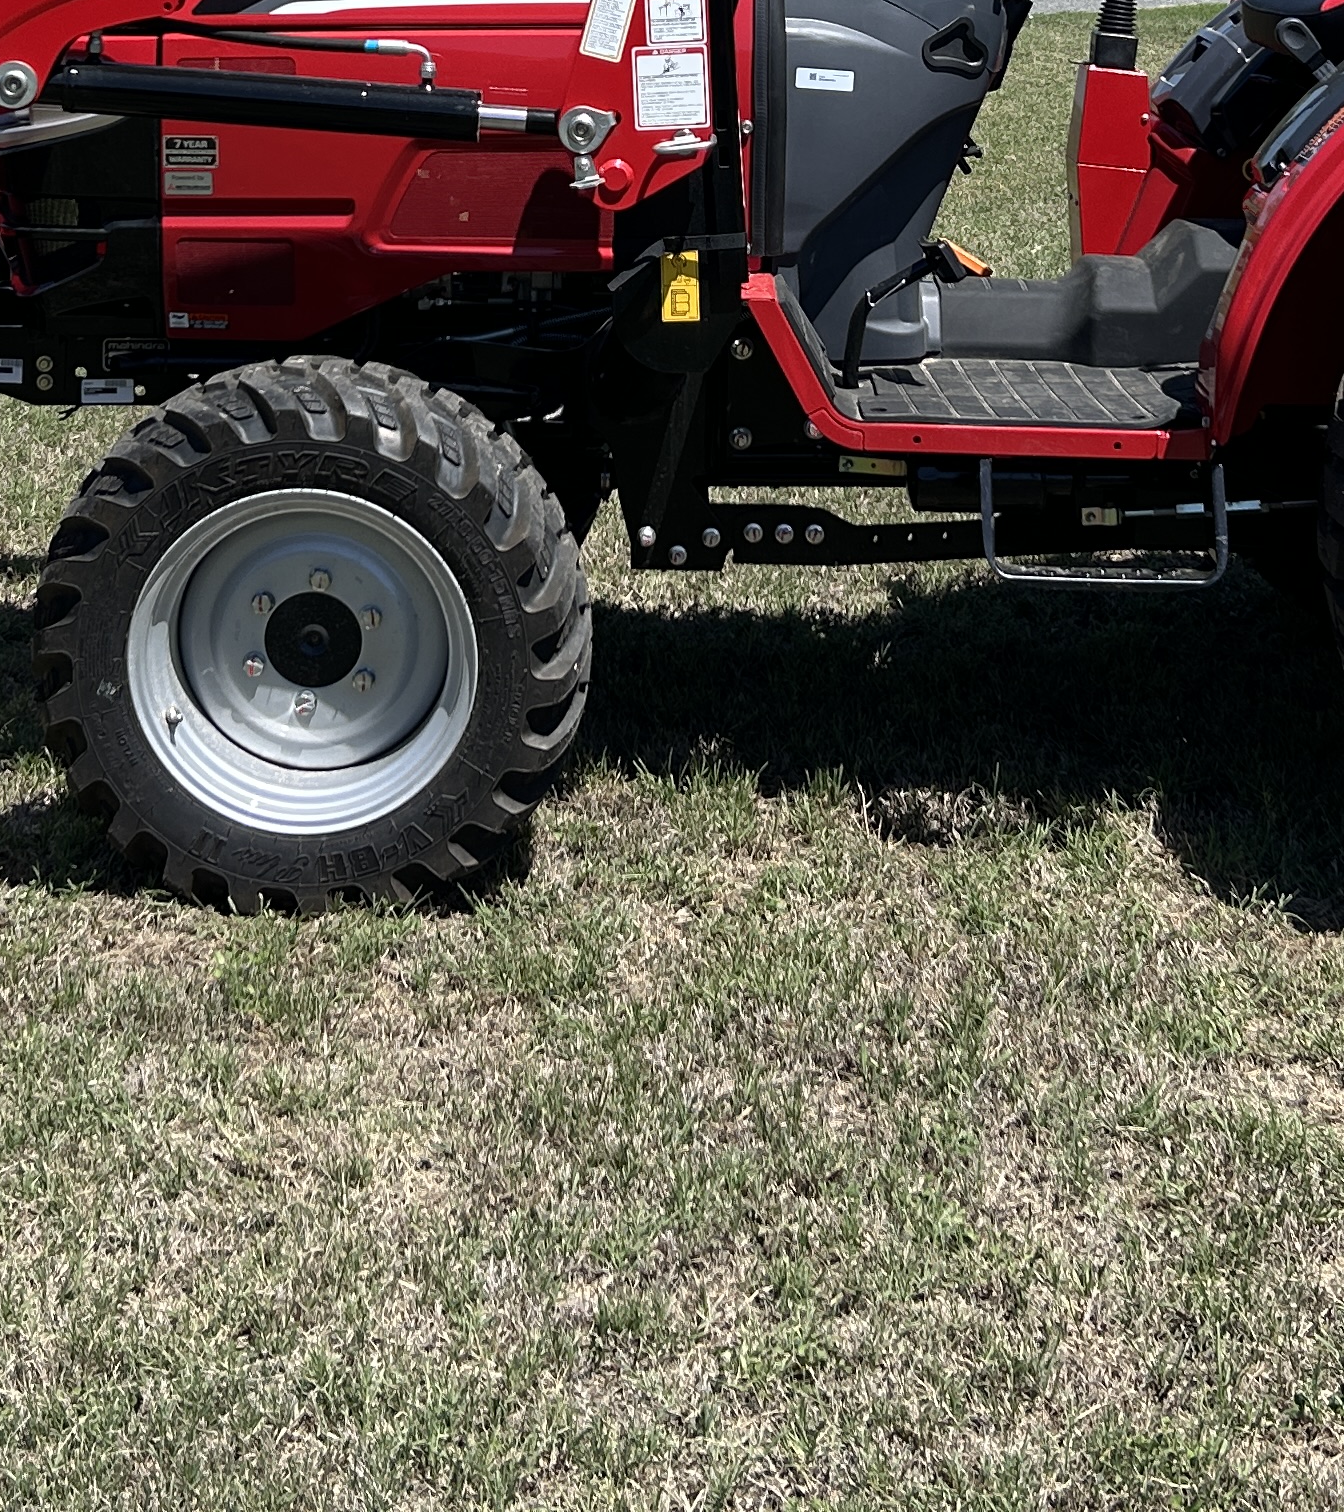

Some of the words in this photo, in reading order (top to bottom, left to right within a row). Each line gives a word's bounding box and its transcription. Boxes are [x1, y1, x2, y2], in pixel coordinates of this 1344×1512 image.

[173, 139, 182, 149] 7
[183, 140, 208, 148] YEAR
[107, 340, 166, 350] mahindra
